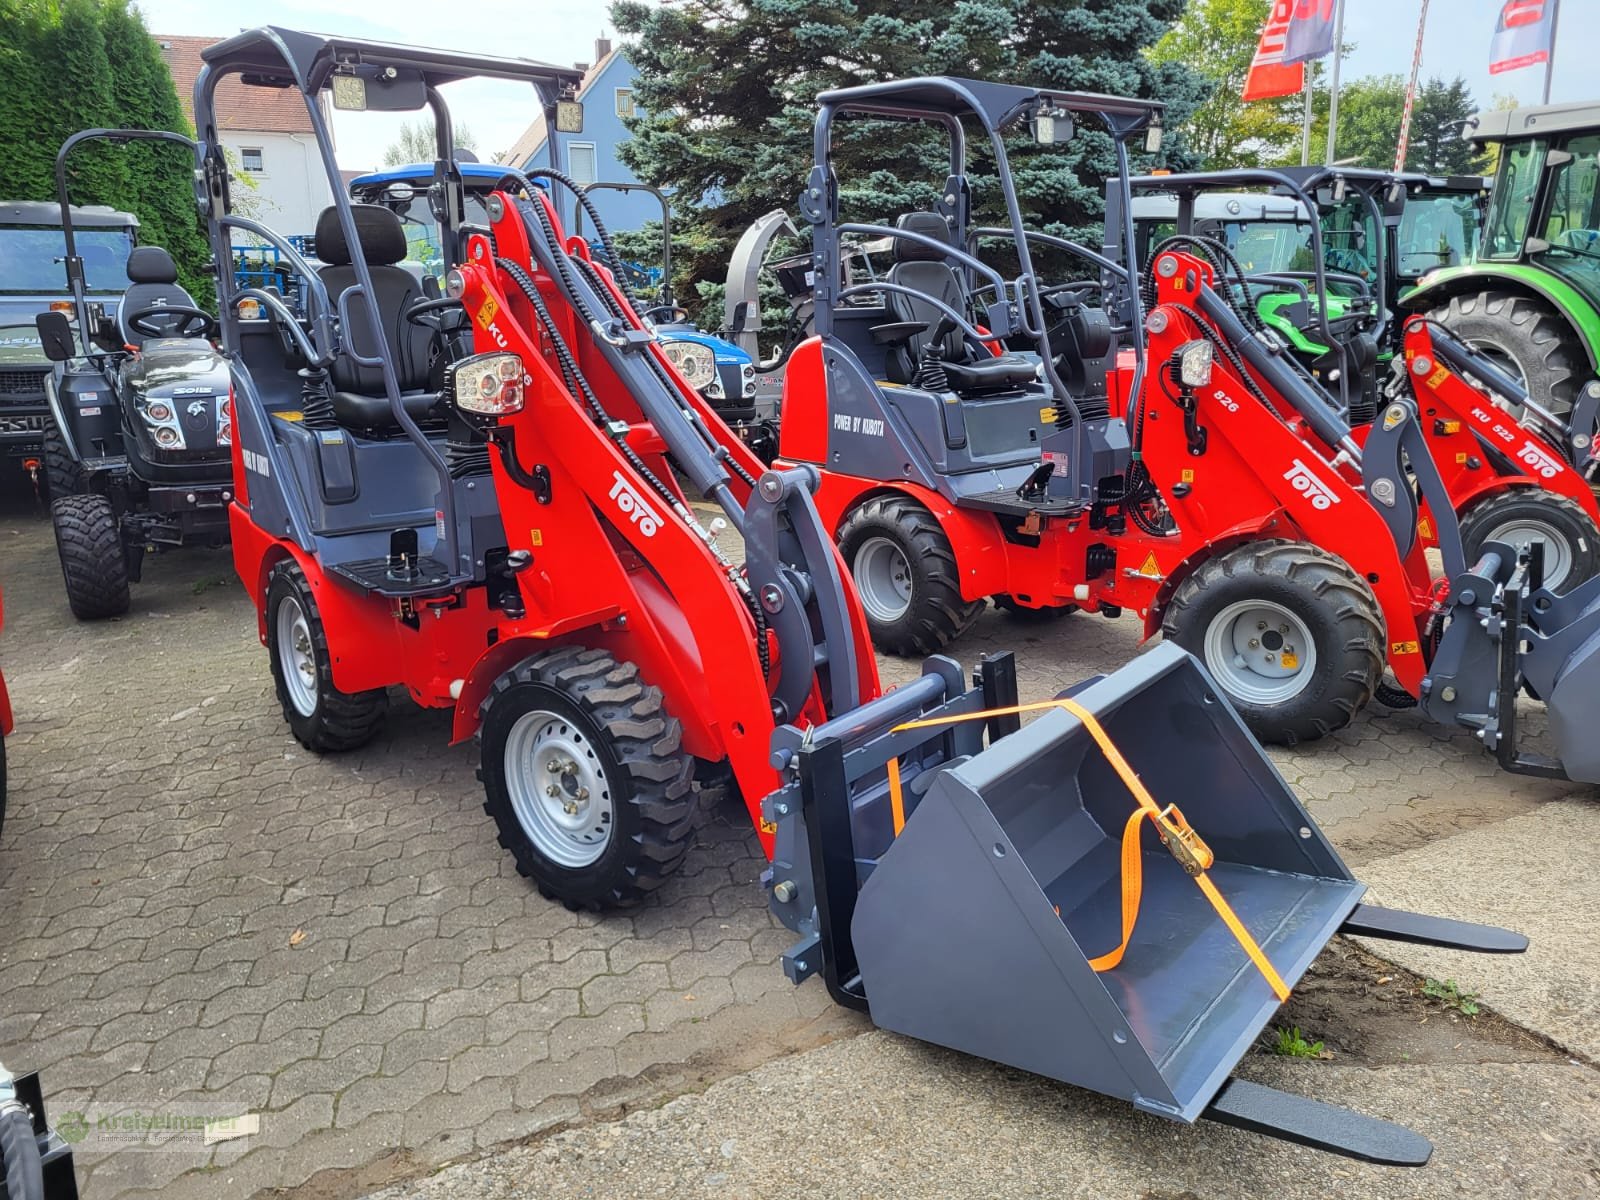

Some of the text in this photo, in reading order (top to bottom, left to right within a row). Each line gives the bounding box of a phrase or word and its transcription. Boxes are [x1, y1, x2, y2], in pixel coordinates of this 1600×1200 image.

[488, 322, 508, 348] KU
[1213, 390, 1239, 412] 826
[834, 413, 884, 437] POWER BY KUBOTA
[1471, 408, 1515, 442] KU 522
